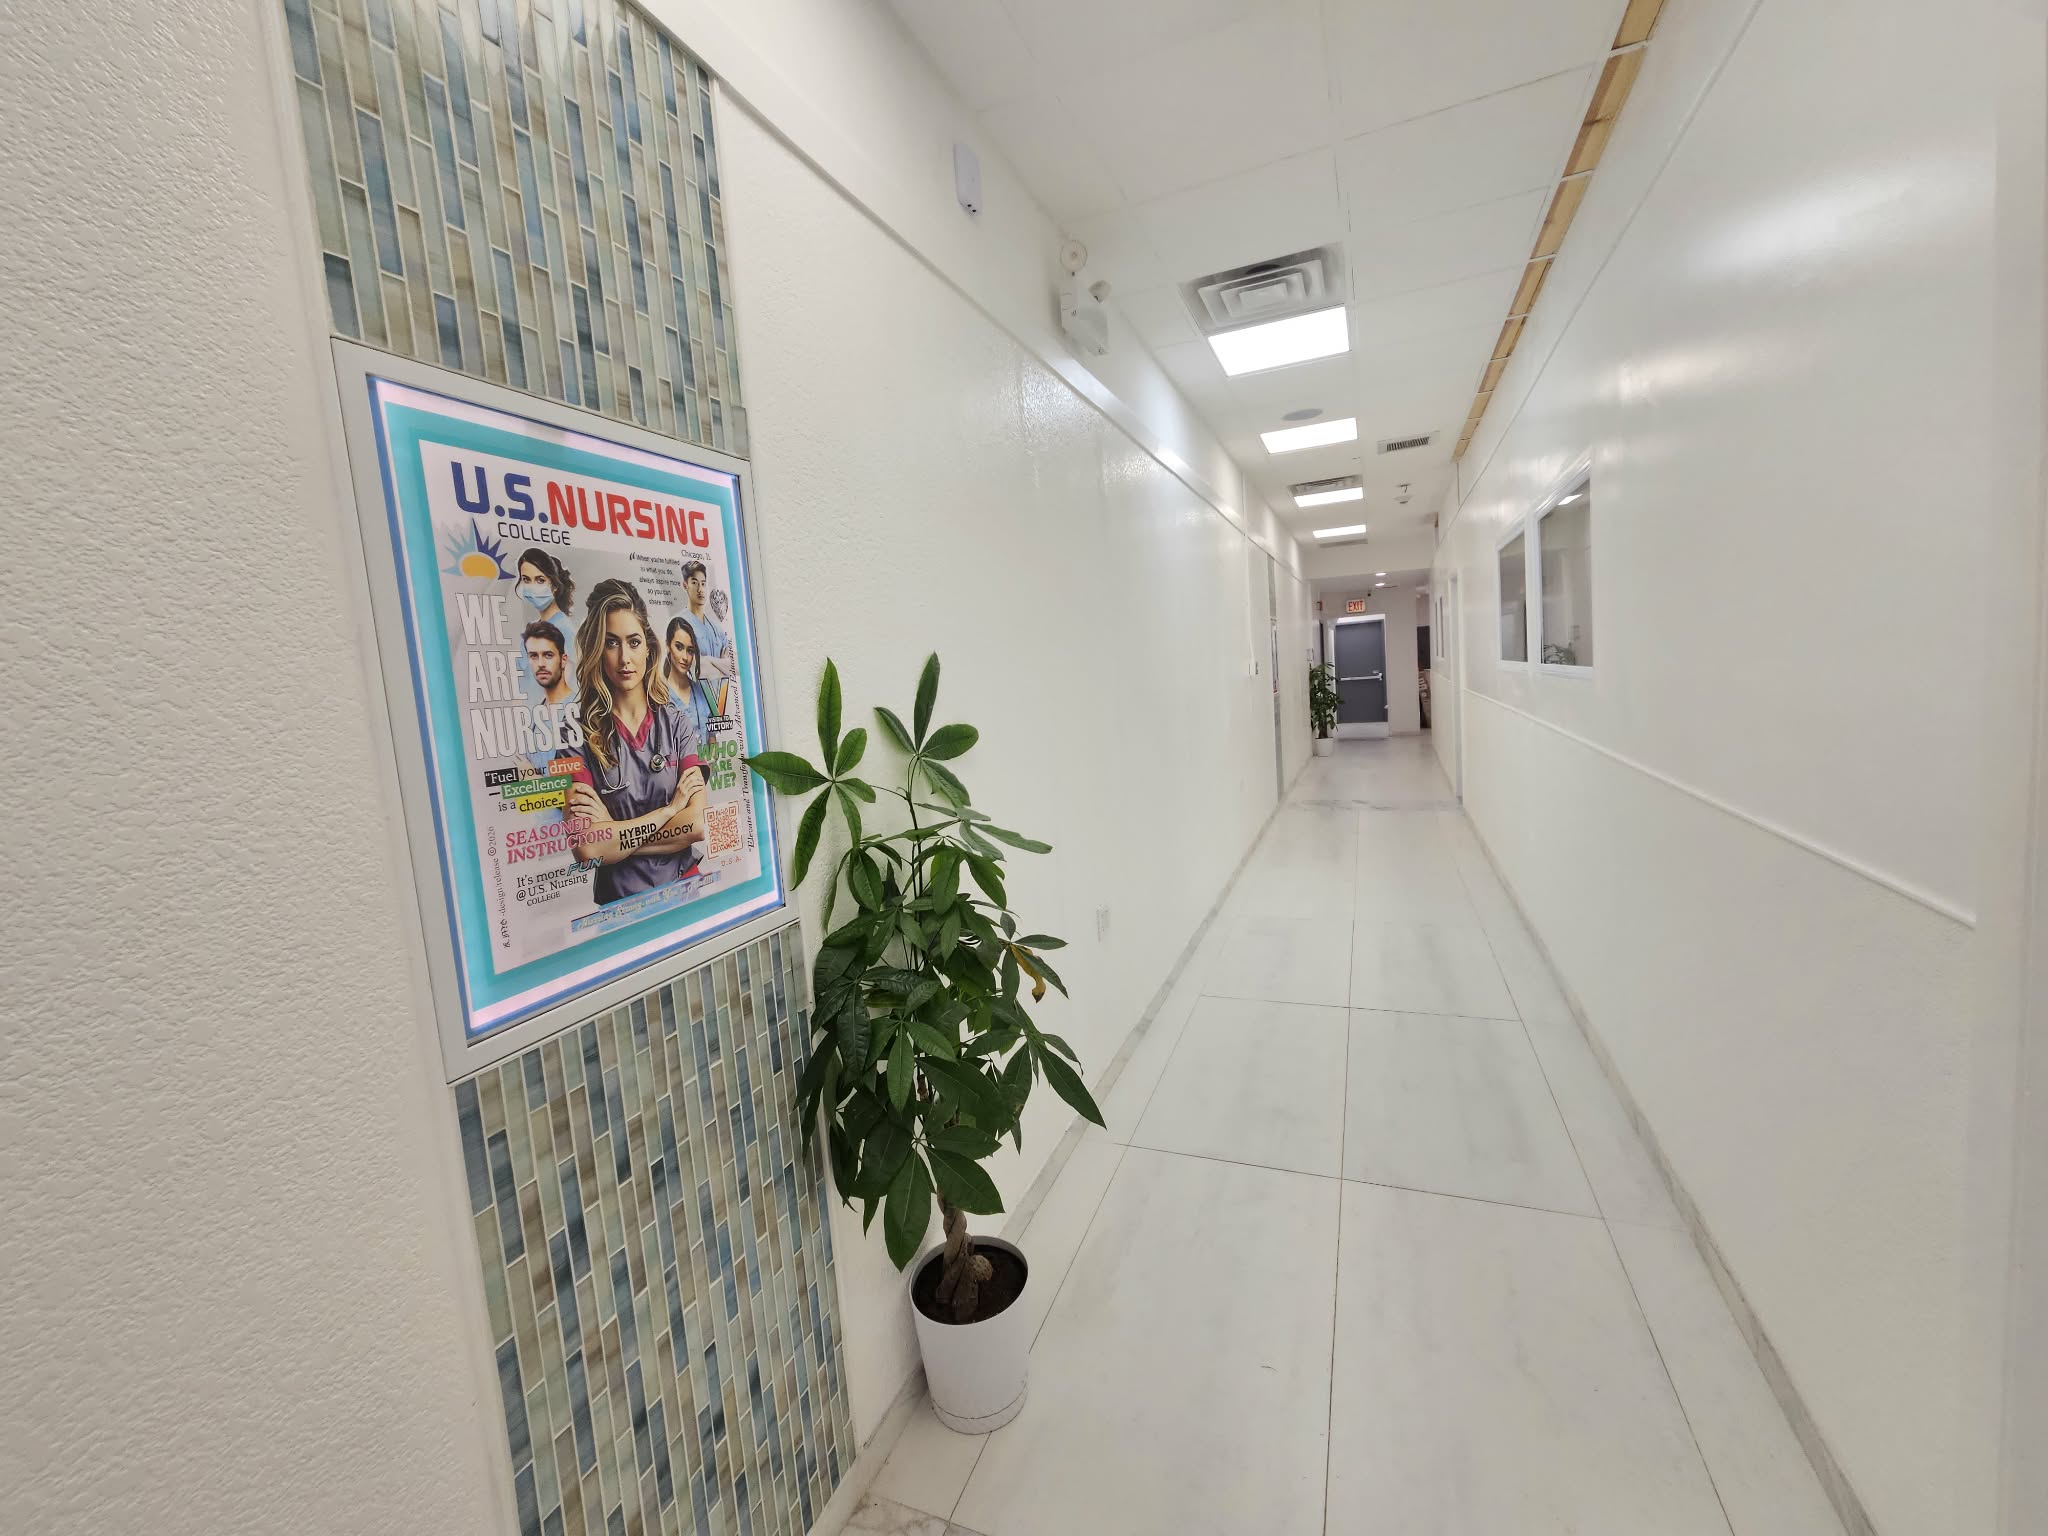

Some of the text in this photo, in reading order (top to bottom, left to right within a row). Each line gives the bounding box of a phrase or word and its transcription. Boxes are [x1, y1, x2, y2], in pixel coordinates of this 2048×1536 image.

[498, 522, 571, 546] COLLEGE
[1348, 600, 1364, 611] EXIT
[455, 593, 512, 646] WE
[468, 651, 528, 703] ARE
[470, 702, 584, 760] NURSES
[706, 720, 733, 732] VICTORY
[697, 740, 738, 761] WHO
[520, 765, 547, 780] your
[549, 761, 581, 775] drive
[711, 759, 732, 772] ARE
[503, 778, 568, 797] Excellence
[709, 771, 736, 791] WE?
[498, 801, 508, 811] is
[510, 801, 516, 809] a
[505, 817, 592, 848] SEASONED
[619, 823, 657, 840] HYBRID
[620, 823, 694, 850] METHODOLOGY
[507, 828, 613, 864] INSTRUCTORS
[516, 856, 603, 888] It's more FUN
[550, 874, 588, 891] Nursing
[526, 891, 561, 906] COLLEGE
